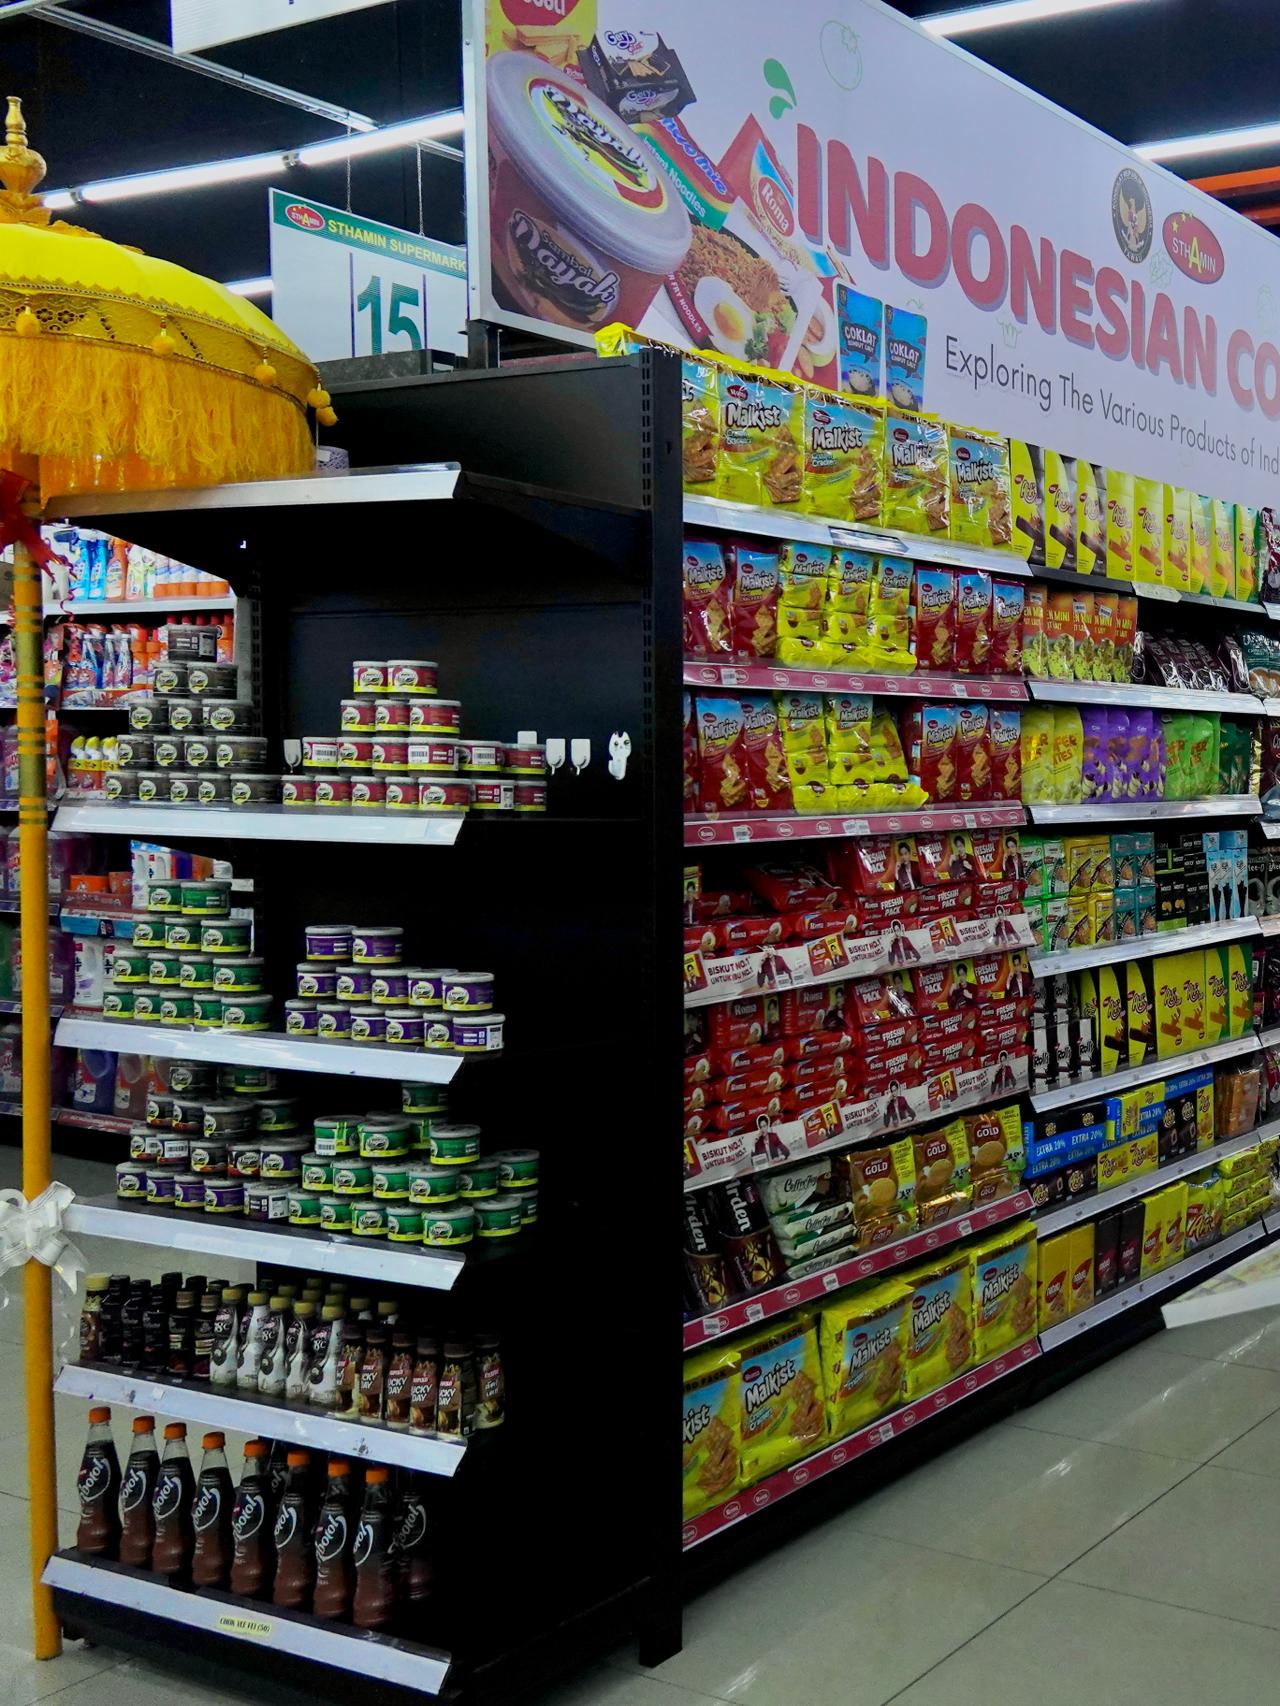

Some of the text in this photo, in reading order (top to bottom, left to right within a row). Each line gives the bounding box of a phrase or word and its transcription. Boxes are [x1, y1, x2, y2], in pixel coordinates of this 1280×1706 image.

[668, 168, 707, 218] Noodles
[761, 182, 789, 232] Roma
[328, 219, 386, 247] STHAMIN
[542, 230, 594, 277] Sambal
[796, 122, 1217, 398] INDONESIAN
[1172, 236, 1216, 274] STHAMIN
[357, 275, 422, 354] 15
[679, 298, 703, 333] NOODLES
[844, 325, 877, 347] COKLAT
[889, 341, 920, 363] COKLAT
[946, 334, 1052, 413] Exploring
[1058, 373, 1094, 414] The
[1100, 391, 1164, 438] Various
[1170, 414, 1239, 461] Products
[1240, 436, 1256, 467] of
[726, 400, 781, 432] Malkist
[812, 423, 864, 453] Malkist
[956, 458, 994, 485] Malkist
[688, 564, 723, 584] Malkist
[793, 560, 825, 576] Malkist
[741, 571, 776, 591] Malkist
[921, 590, 951, 608] Malkist
[789, 704, 819, 720] Malkist
[841, 706, 869, 722] Malkist
[703, 719, 738, 741] Malkist
[927, 724, 953, 746] Malkist
[707, 962, 735, 977] BISKUT
[980, 973, 997, 985] PACK
[844, 1109, 866, 1122] BISKUT
[976, 1126, 999, 1138] GOLD
[1071, 1132, 1090, 1145] EXTRA
[701, 1146, 727, 1161] BISKUT
[927, 1143, 947, 1157] GOLD
[1036, 1143, 1053, 1157] EXTRA
[865, 1161, 888, 1176] GOLD
[982, 1263, 1019, 1306] Malkist
[913, 1291, 950, 1336] Malkist
[849, 1327, 891, 1374] Malkist
[746, 1358, 797, 1414] Malkist
[411, 1394, 427, 1403] DAY
